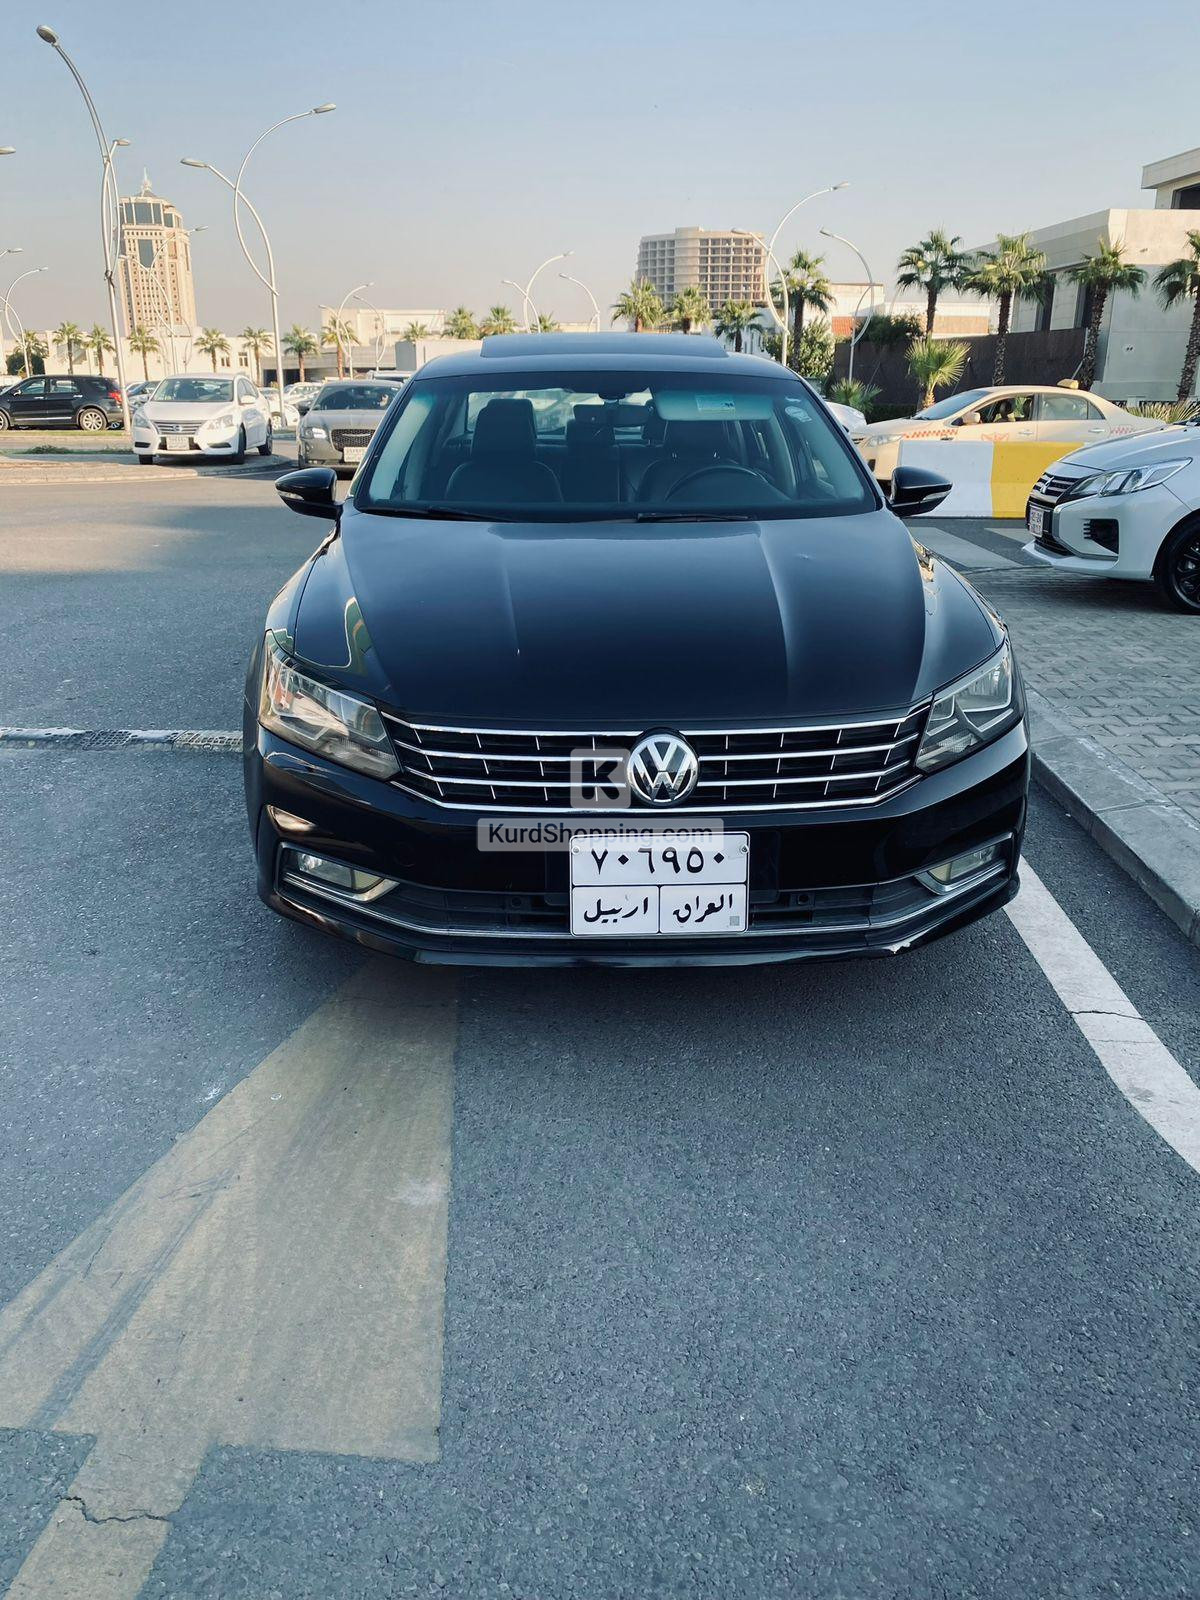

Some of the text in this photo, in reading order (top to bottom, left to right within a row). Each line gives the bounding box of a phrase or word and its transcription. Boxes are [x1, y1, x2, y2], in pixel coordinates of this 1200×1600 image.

[627, 734, 699, 804] VW
[590, 846, 725, 875] ٧٠٦٩٥٠
[583, 893, 734, 924] العراق اربيل
